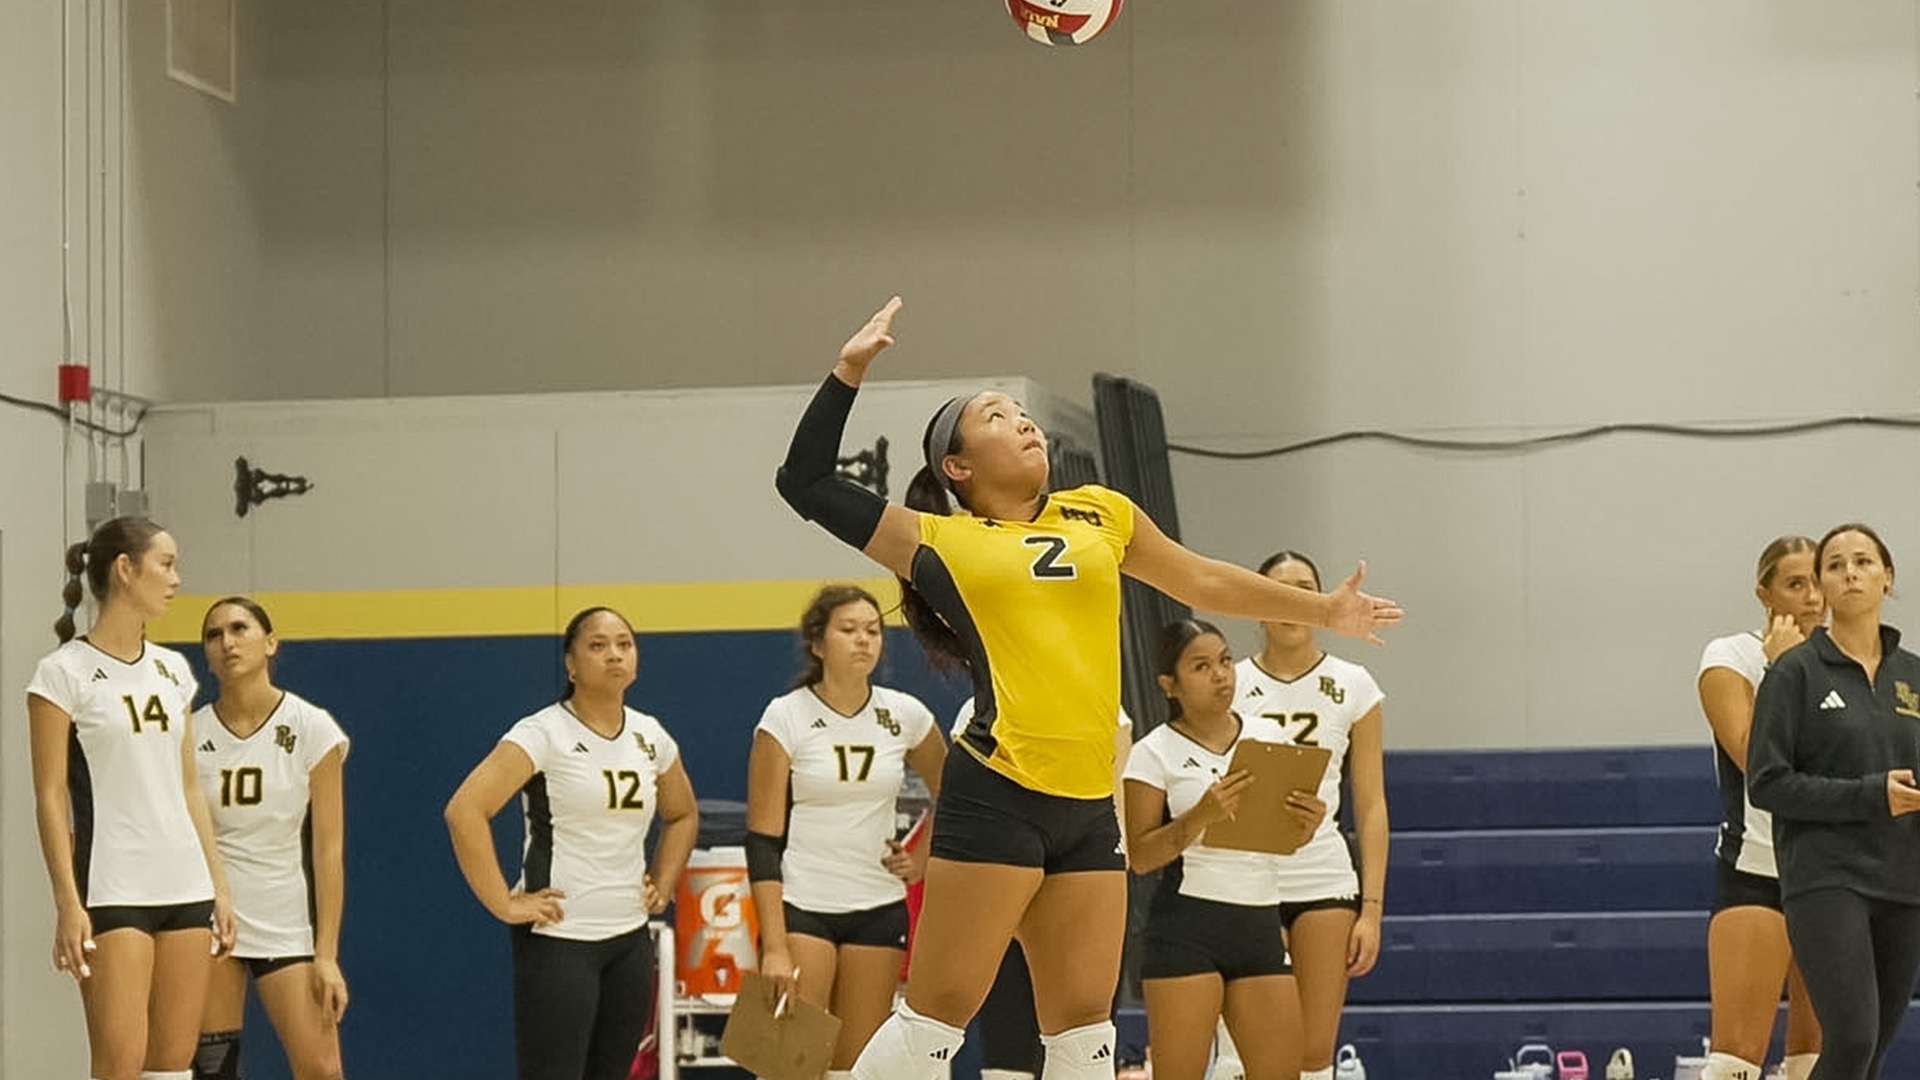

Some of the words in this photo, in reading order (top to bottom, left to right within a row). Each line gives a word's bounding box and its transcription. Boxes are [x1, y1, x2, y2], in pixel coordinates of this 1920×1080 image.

[1024, 534, 1078, 580] 2
[121, 694, 170, 734] 14
[833, 744, 876, 783] 17
[219, 766, 263, 807] 10
[602, 769, 644, 810] 12
[700, 882, 742, 929] G
